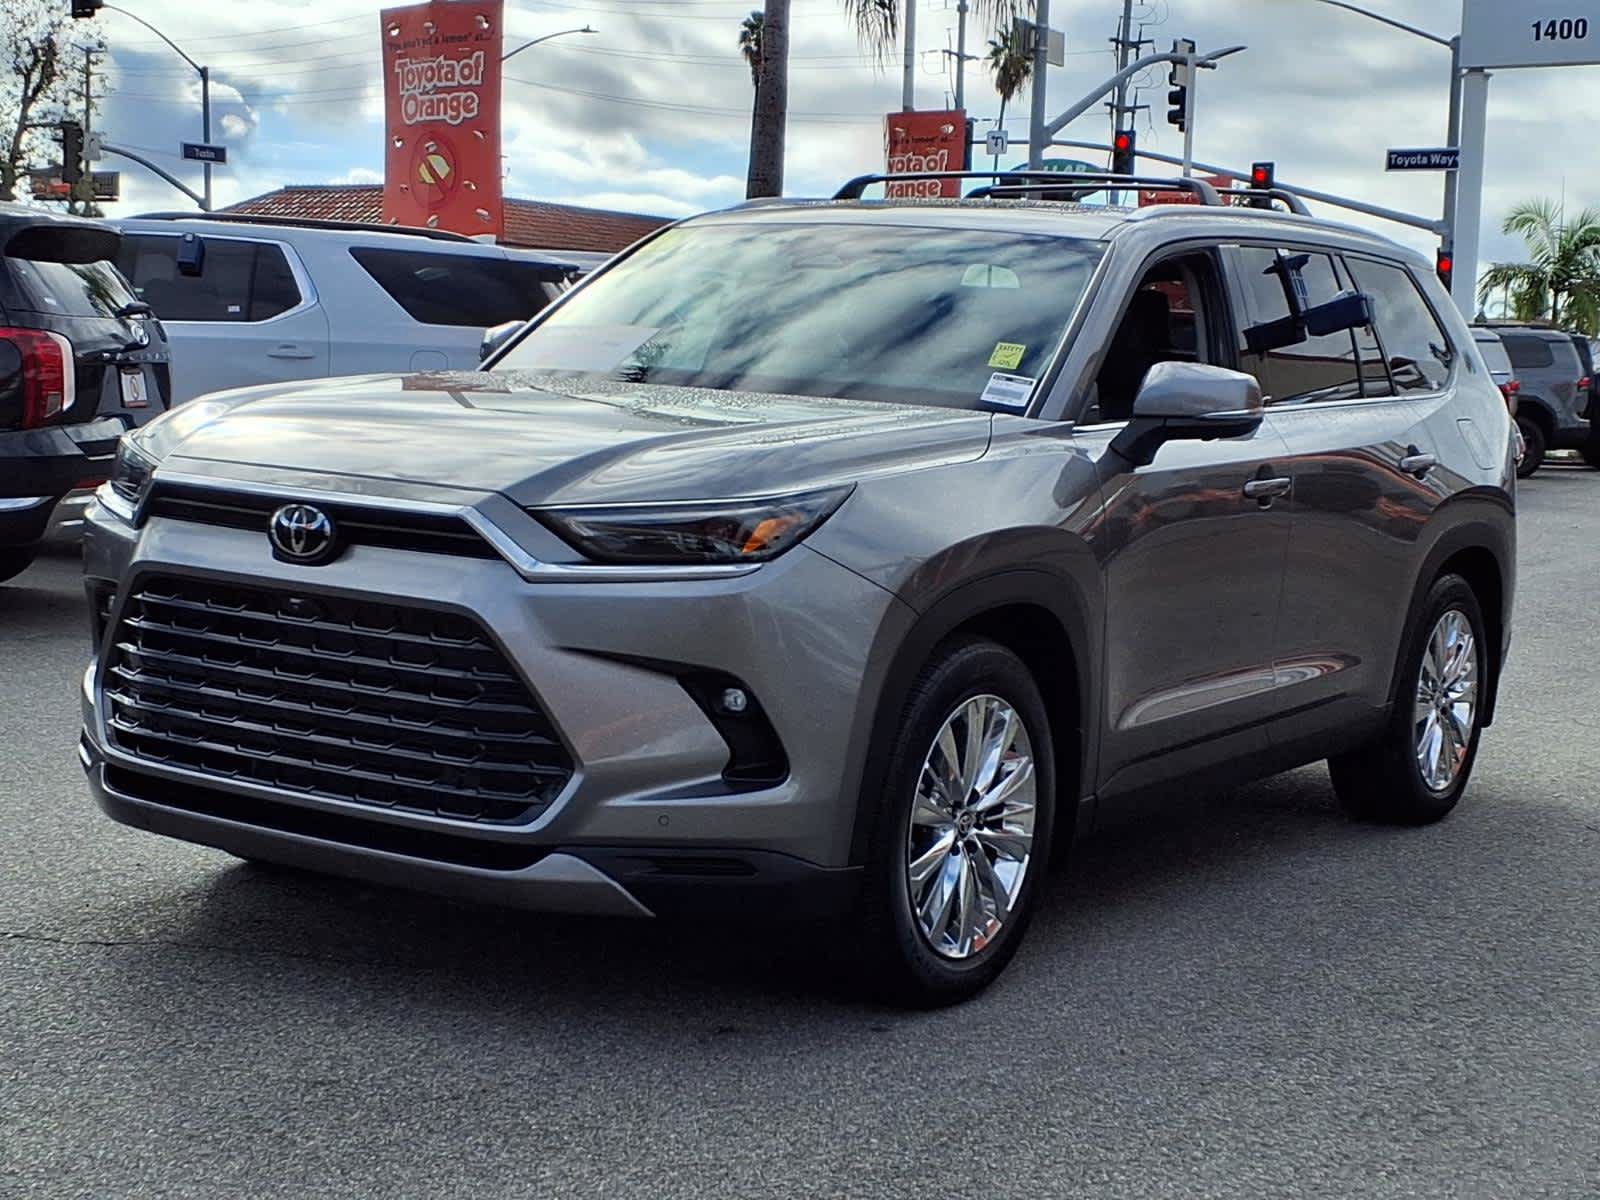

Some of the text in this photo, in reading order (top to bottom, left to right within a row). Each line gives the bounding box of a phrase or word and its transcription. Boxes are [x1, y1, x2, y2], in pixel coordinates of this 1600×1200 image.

[1531, 18, 1588, 41] 1400
[395, 51, 484, 95] Toyota of
[402, 91, 478, 124] Orange
[888, 149, 948, 172] yota of
[1390, 153, 1455, 166] Toyota Way
[888, 179, 942, 197] range
